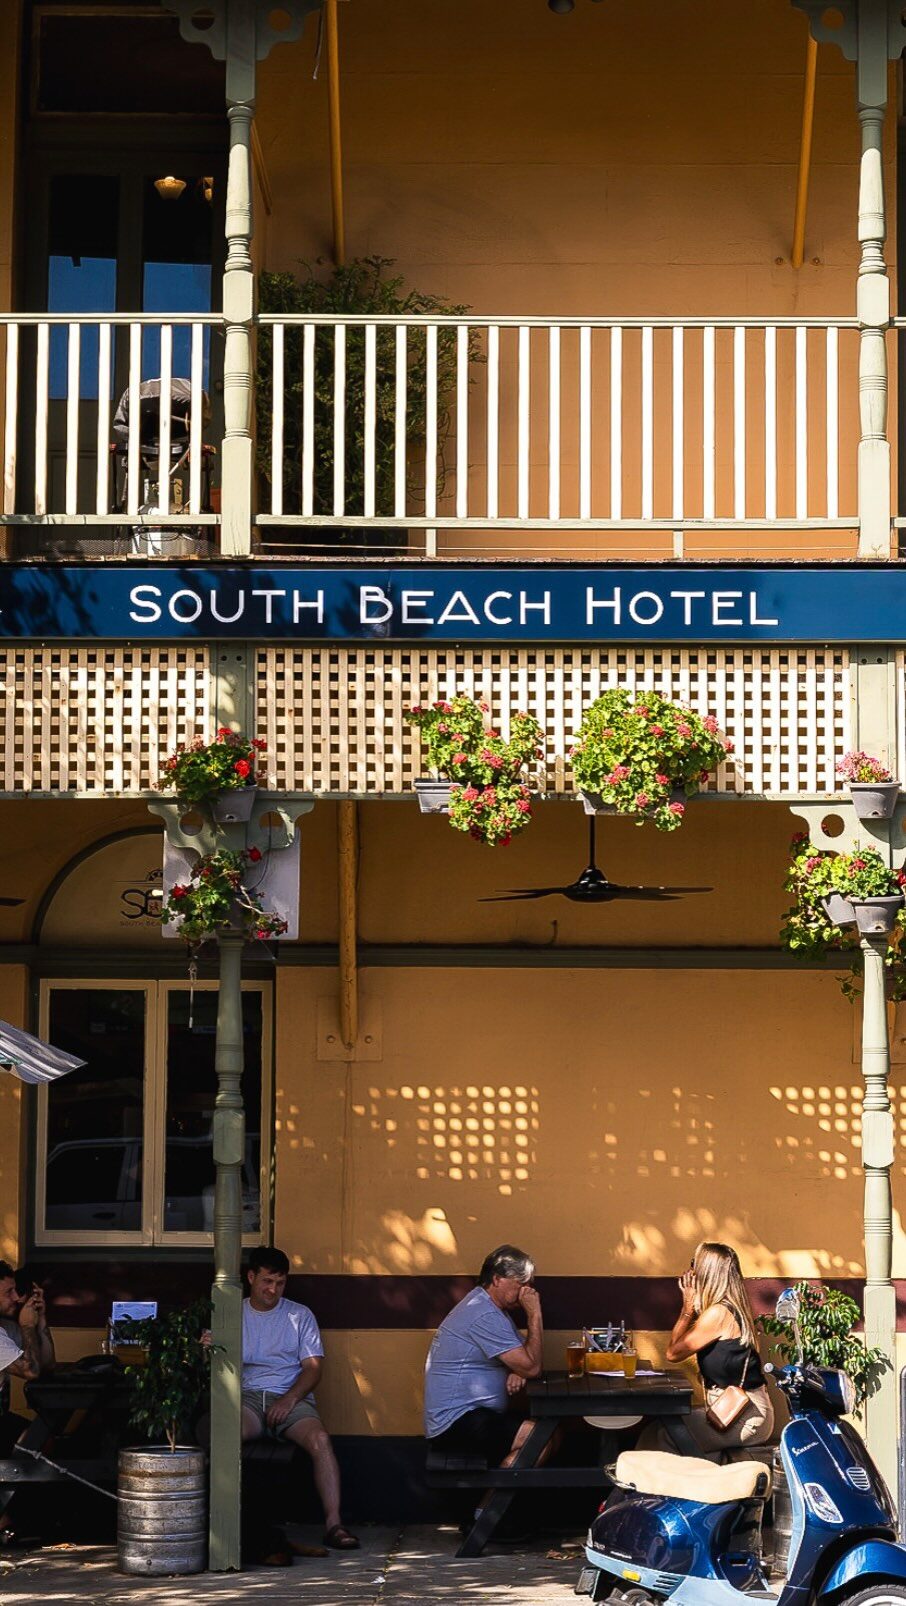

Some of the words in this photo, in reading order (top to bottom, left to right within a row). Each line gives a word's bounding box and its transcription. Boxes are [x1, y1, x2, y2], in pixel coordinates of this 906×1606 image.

[129, 584, 324, 624] SOUTH
[359, 585, 551, 625] BEACH
[585, 585, 779, 626] HOTEL
